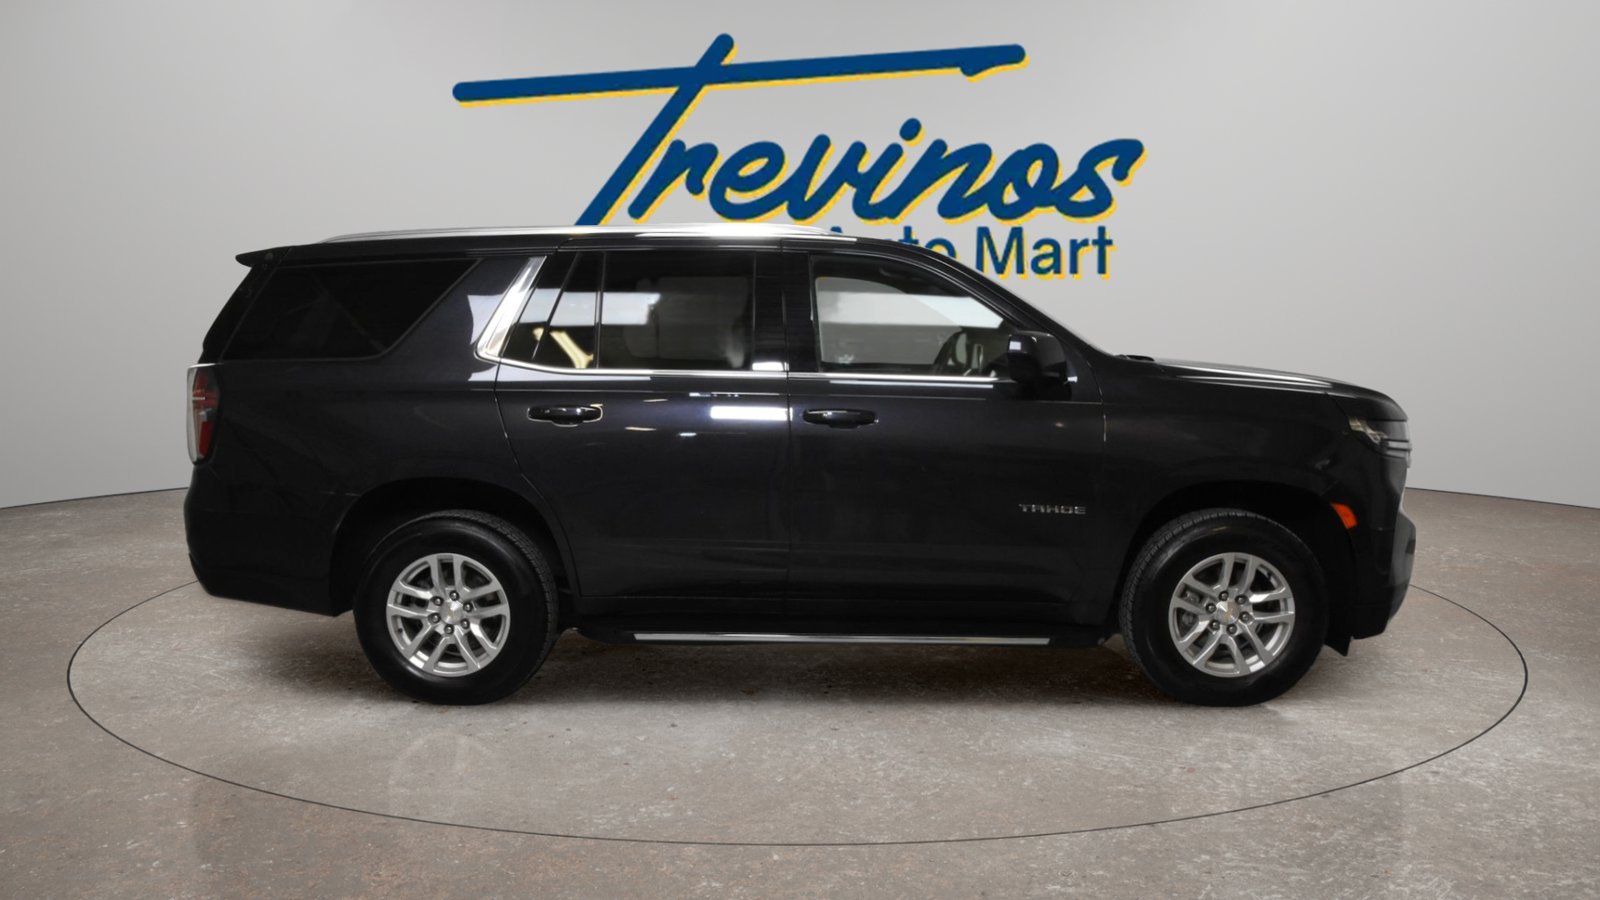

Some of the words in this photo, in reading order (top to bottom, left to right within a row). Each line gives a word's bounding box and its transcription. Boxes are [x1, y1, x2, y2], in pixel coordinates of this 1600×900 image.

[452, 34, 1146, 225] Trevinos
[975, 226, 1114, 278] Mart
[1018, 503, 1086, 515] TAHOE
